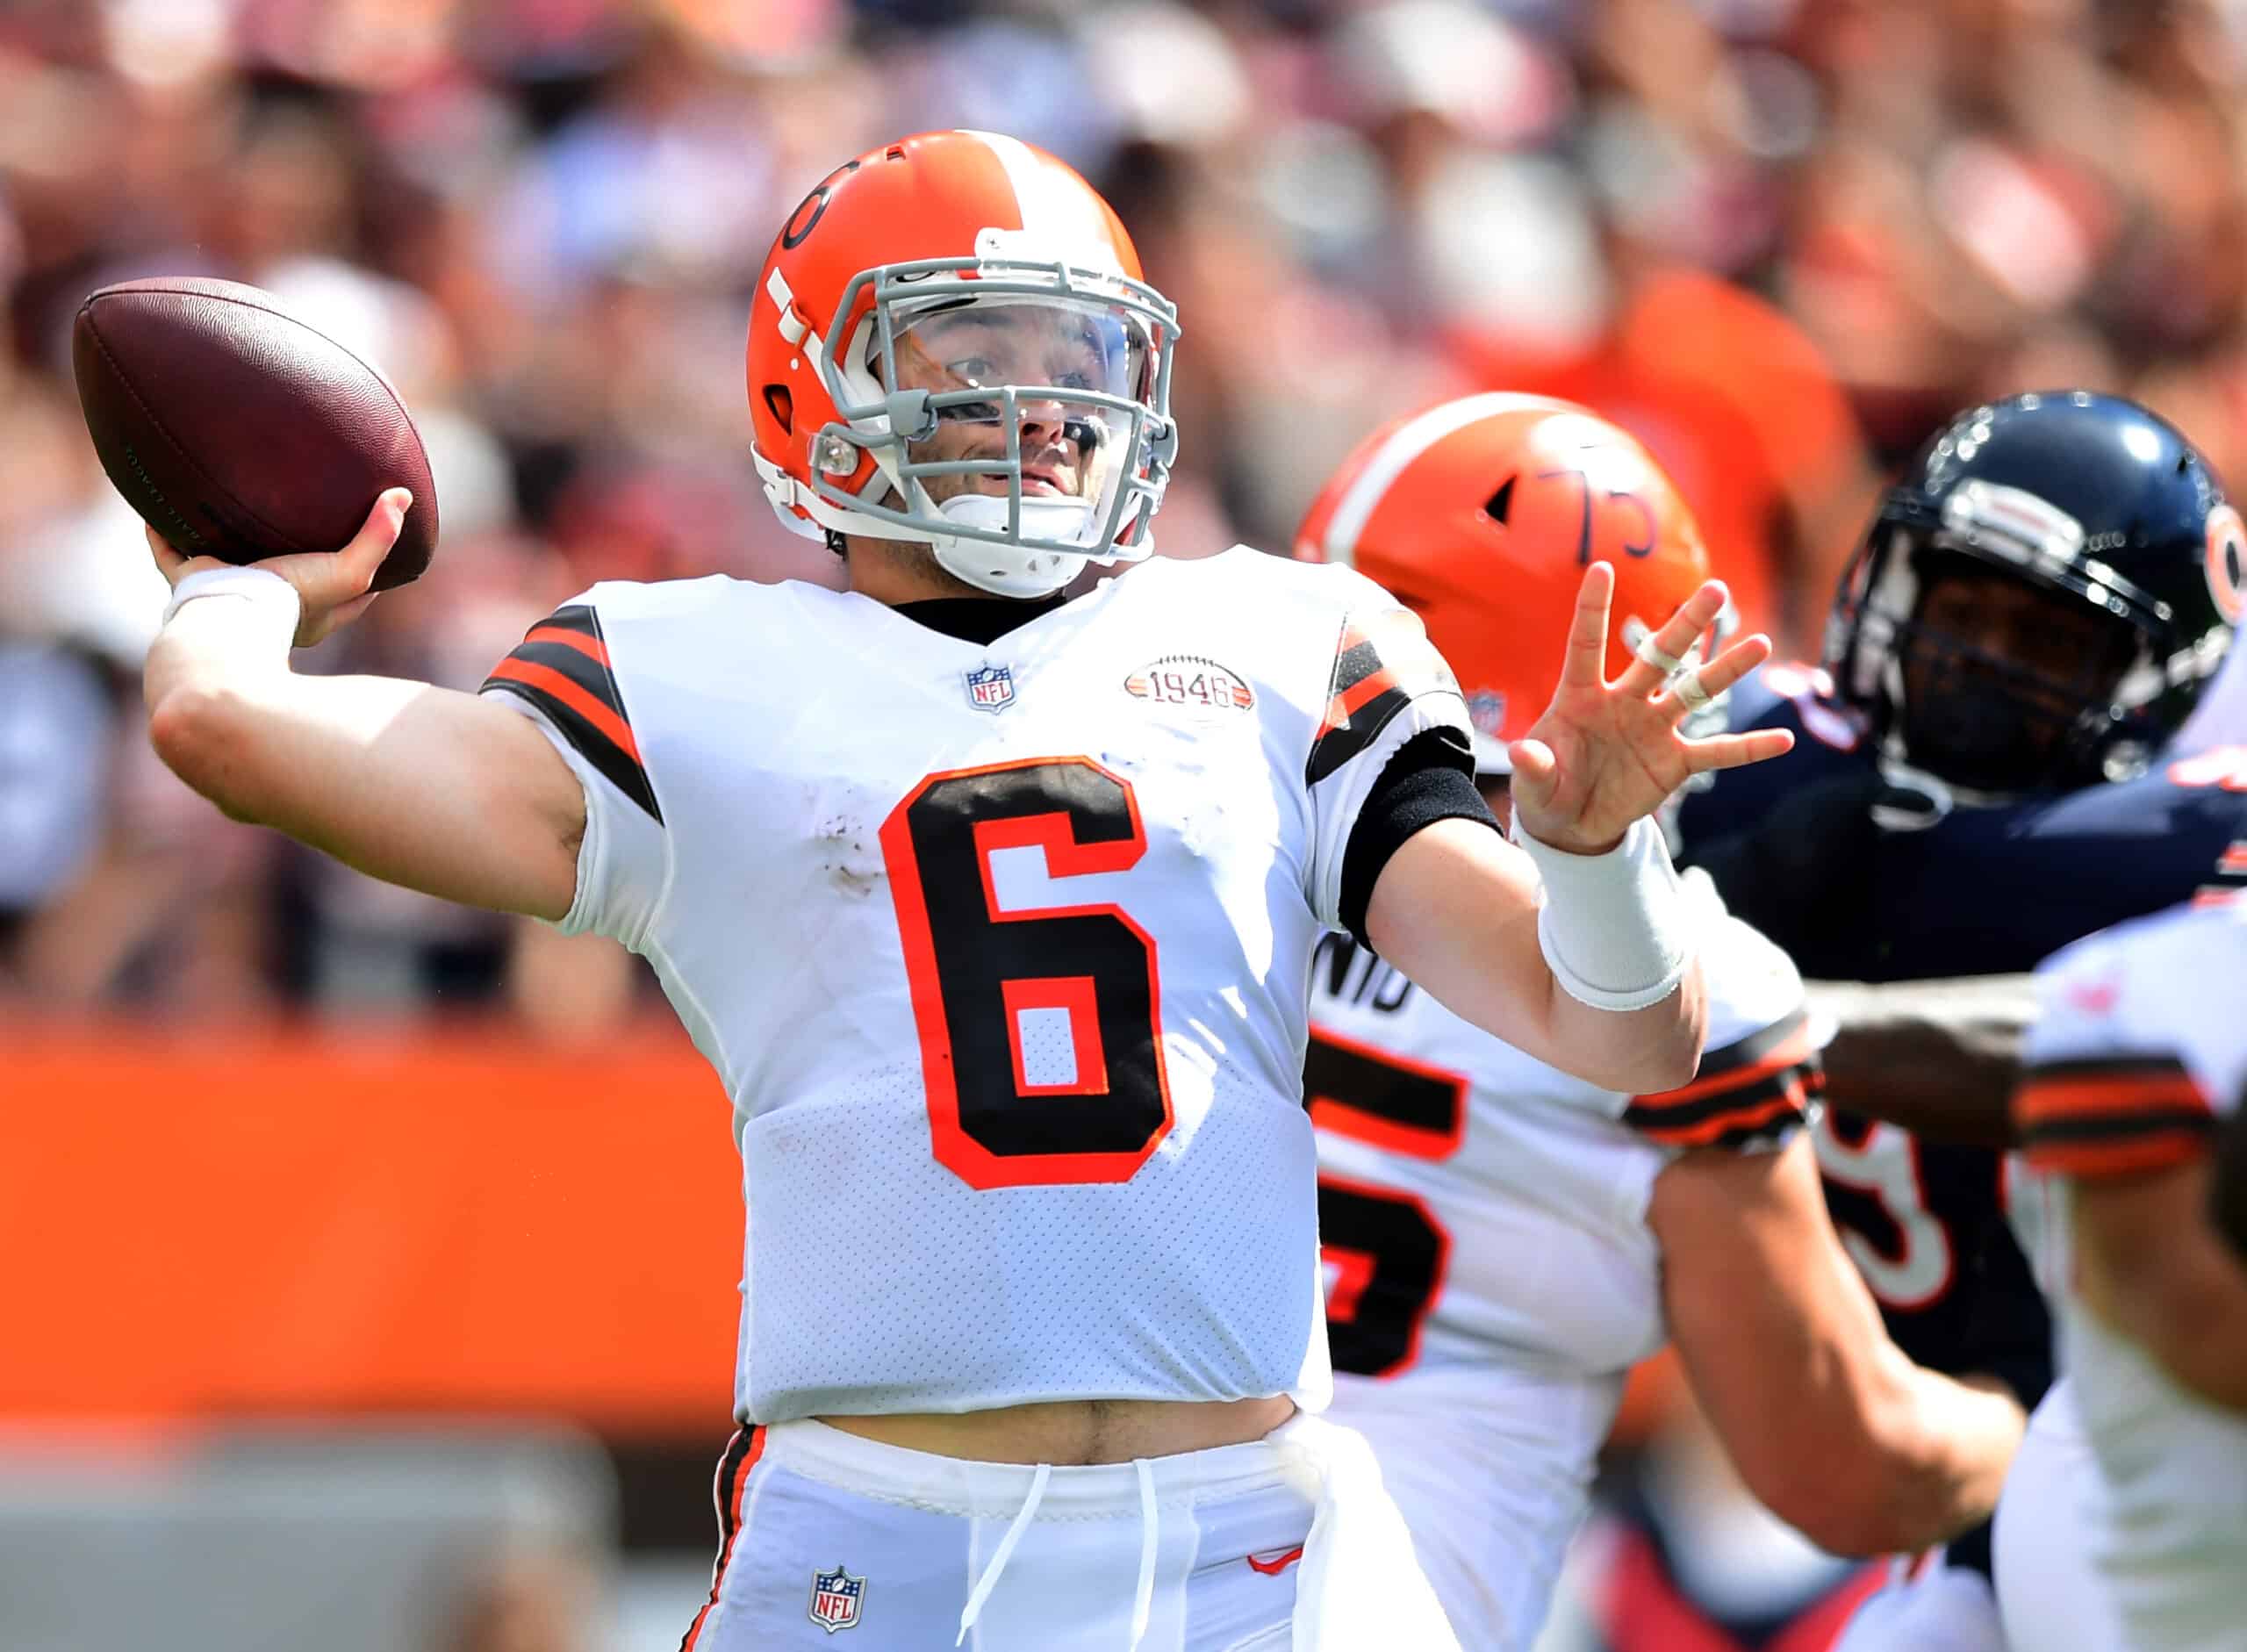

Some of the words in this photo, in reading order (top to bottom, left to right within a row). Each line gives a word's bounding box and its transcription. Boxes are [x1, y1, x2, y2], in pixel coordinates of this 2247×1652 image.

[973, 682, 1011, 702] NFL
[1150, 671, 1231, 707] 1946
[878, 755, 1174, 1190] 6
[816, 1593, 852, 1620] NFL
